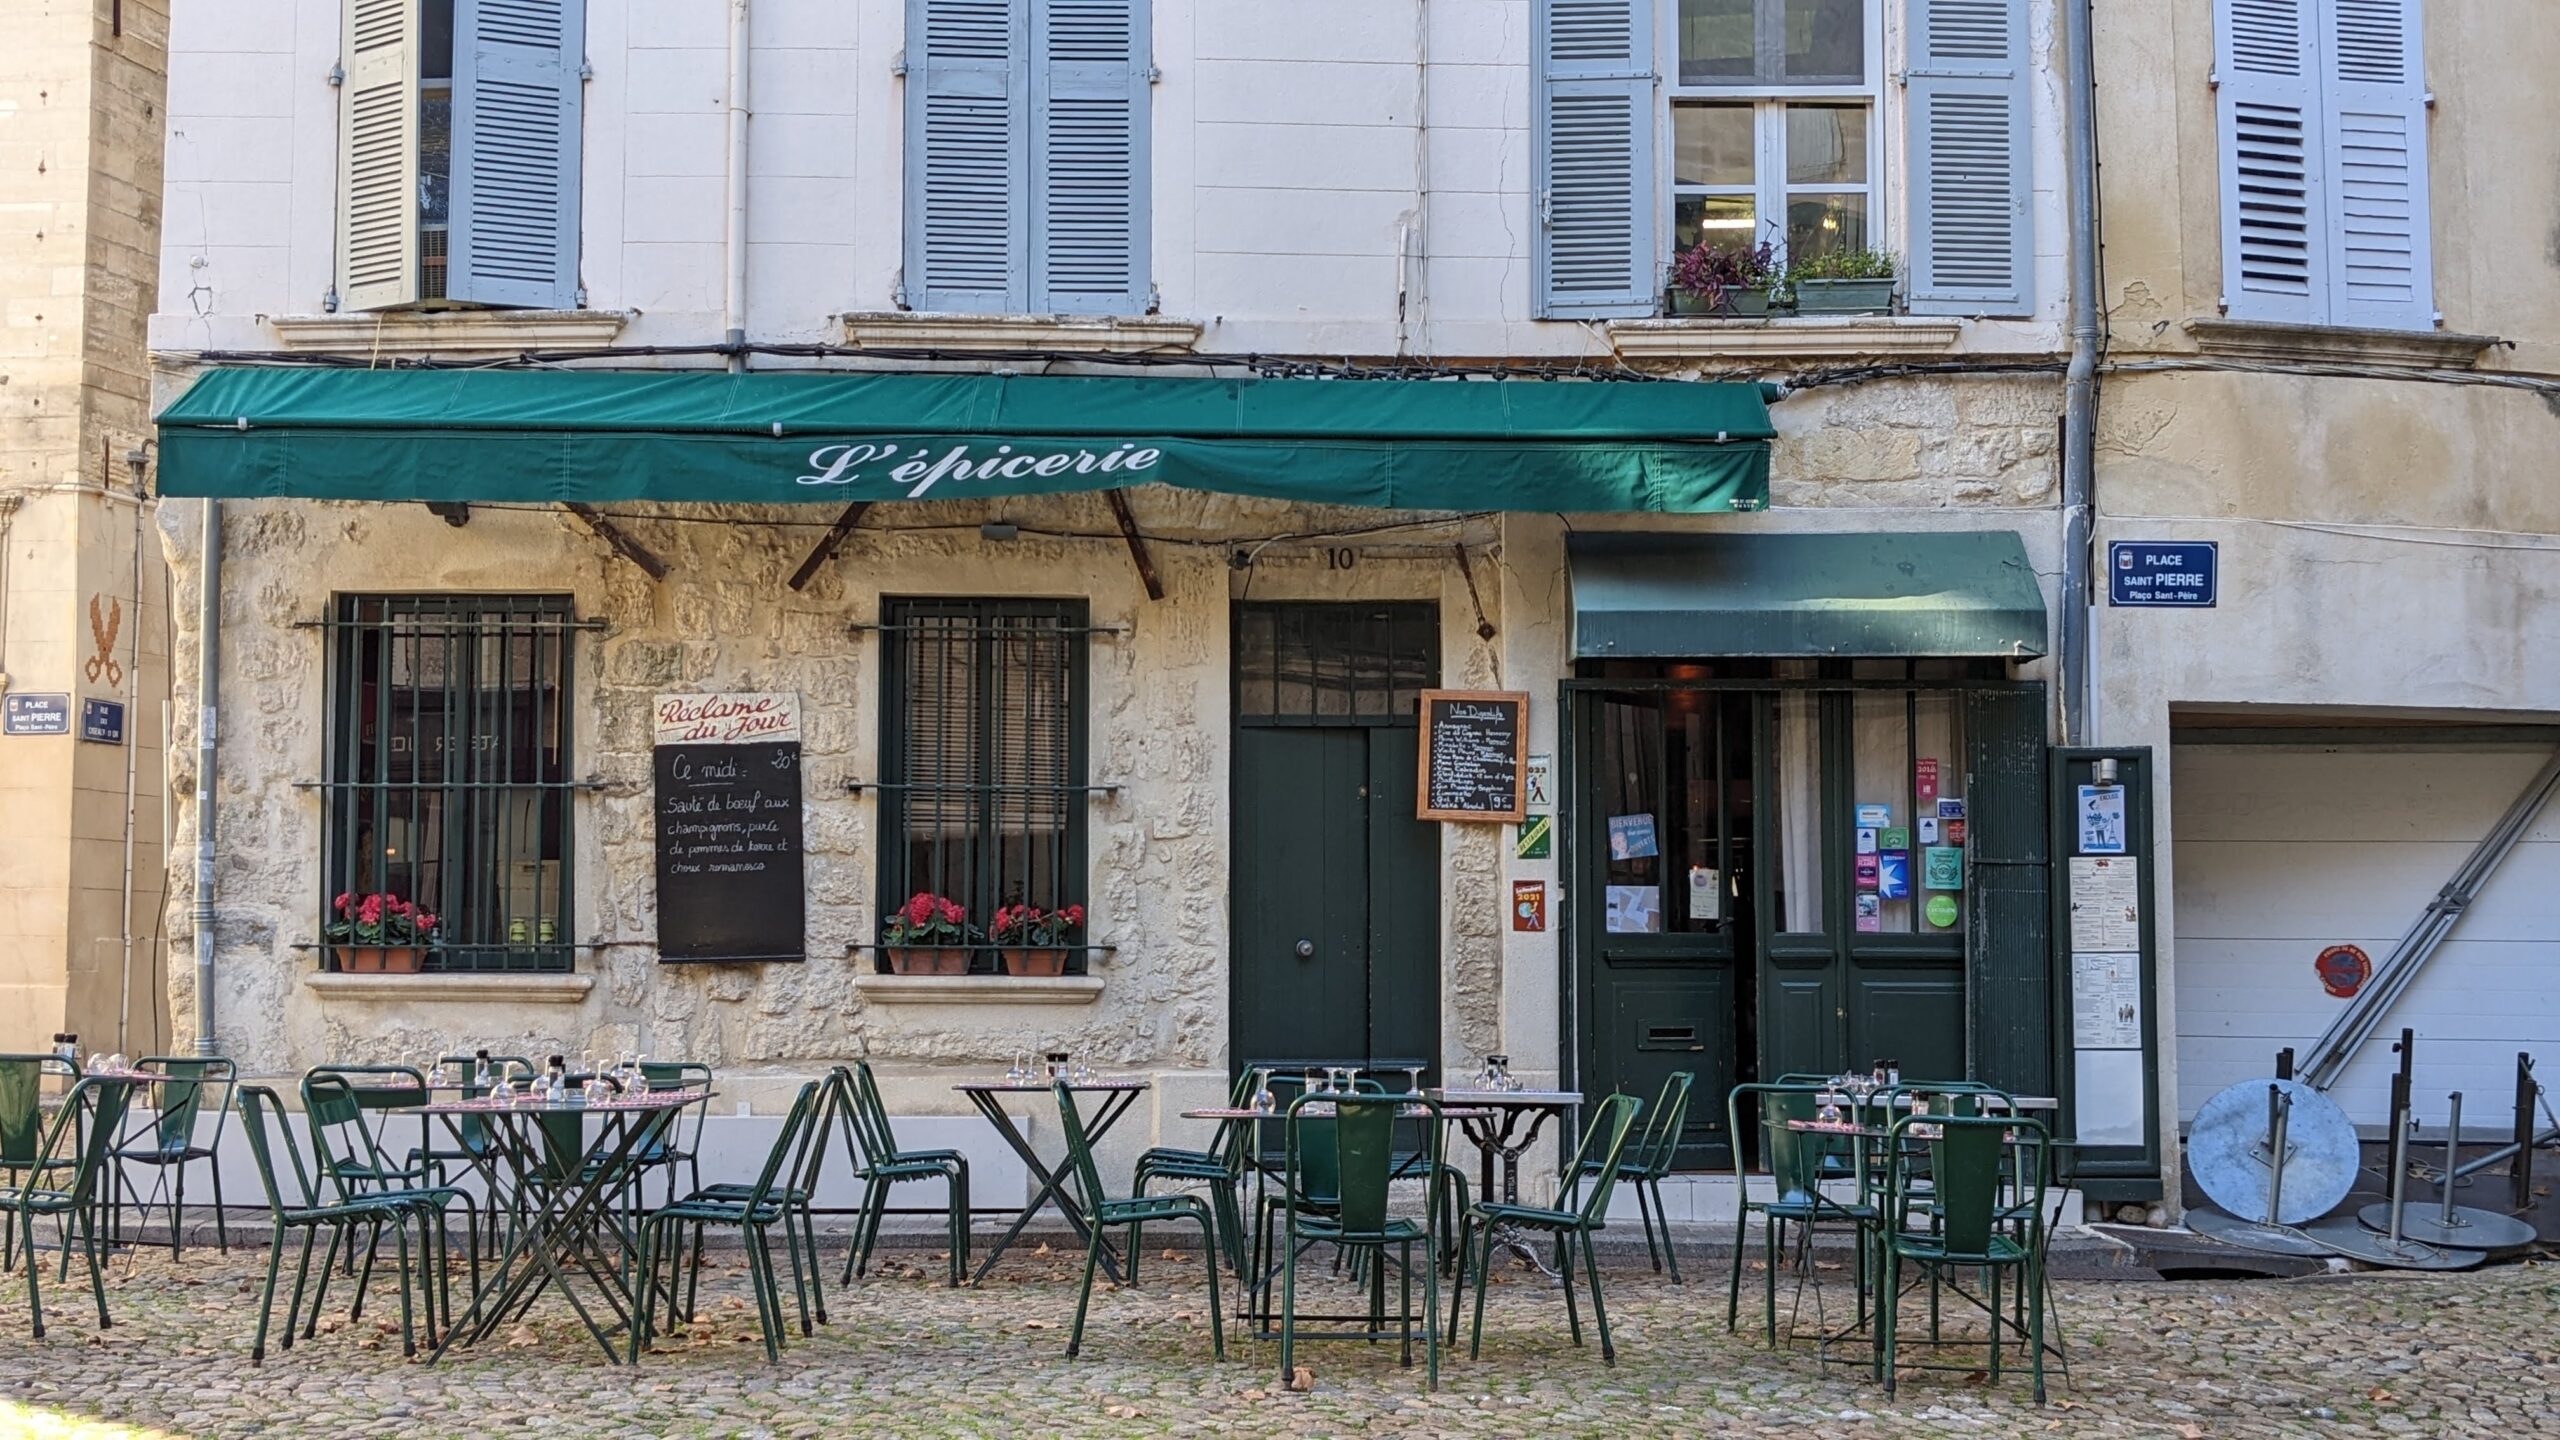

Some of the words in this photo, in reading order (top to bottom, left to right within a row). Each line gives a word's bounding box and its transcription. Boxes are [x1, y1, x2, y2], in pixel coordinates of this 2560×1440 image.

[796, 443, 1160, 498] L'épicerie
[1328, 547, 1354, 570] 10
[2145, 554, 2183, 566] PLACE
[2123, 576, 2153, 586] SAINT
[2155, 573, 2204, 586] PIERRE
[25, 700, 48, 709] PLACE
[660, 695, 785, 724] Réclame
[31, 712, 62, 722] PIERRE
[681, 721, 718, 741] du
[724, 712, 792, 741] Jour
[707, 794, 721, 812] de
[764, 799, 790, 809] aux
[1519, 818, 1549, 852] RESTAURANT
[669, 840, 684, 856] de
[730, 840, 744, 853] de
[777, 838, 788, 851] et
[1517, 893, 1540, 901] 2021
